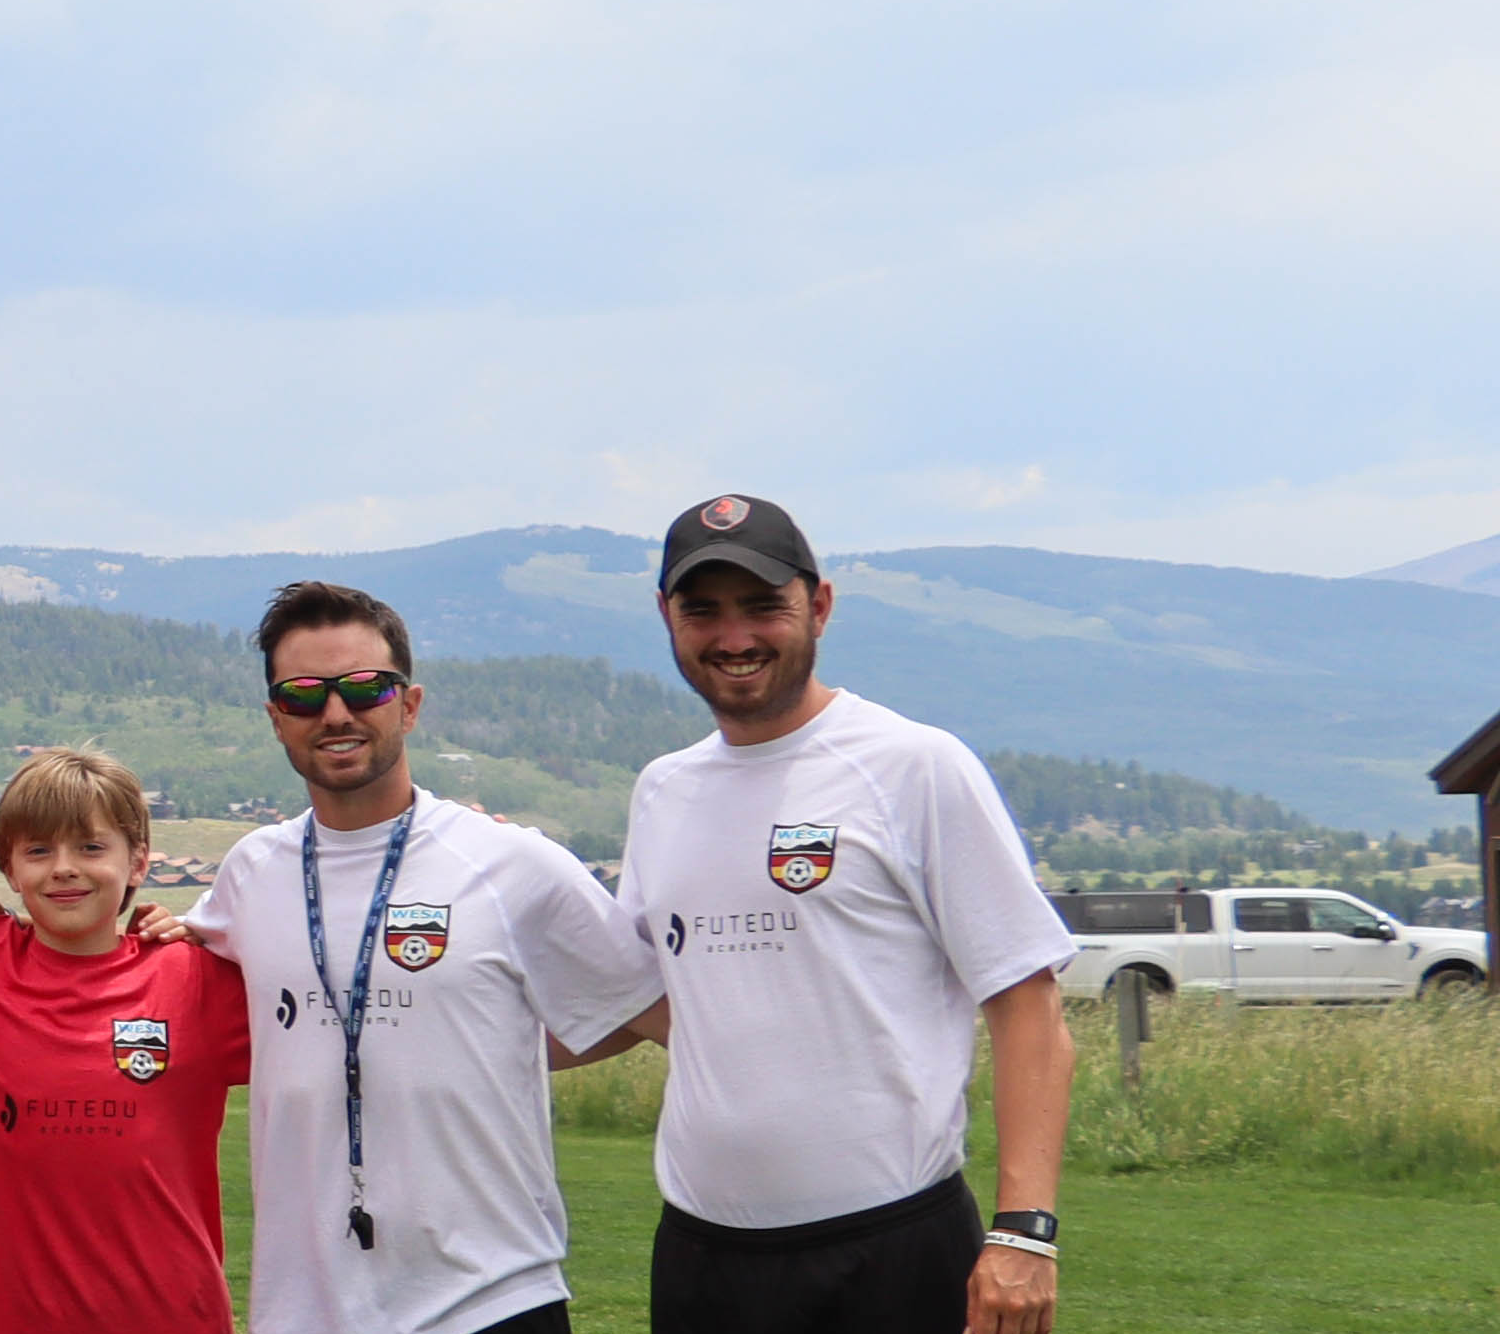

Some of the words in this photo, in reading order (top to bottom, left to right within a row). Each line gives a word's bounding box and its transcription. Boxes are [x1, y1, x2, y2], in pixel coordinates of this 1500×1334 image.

[777, 829, 831, 840] WESA
[391, 909, 445, 919] WESA
[694, 911, 798, 936] FUTEDU
[706, 941, 785, 953] academy
[117, 1023, 164, 1035] WESA
[26, 1099, 137, 1119] FUTEDU
